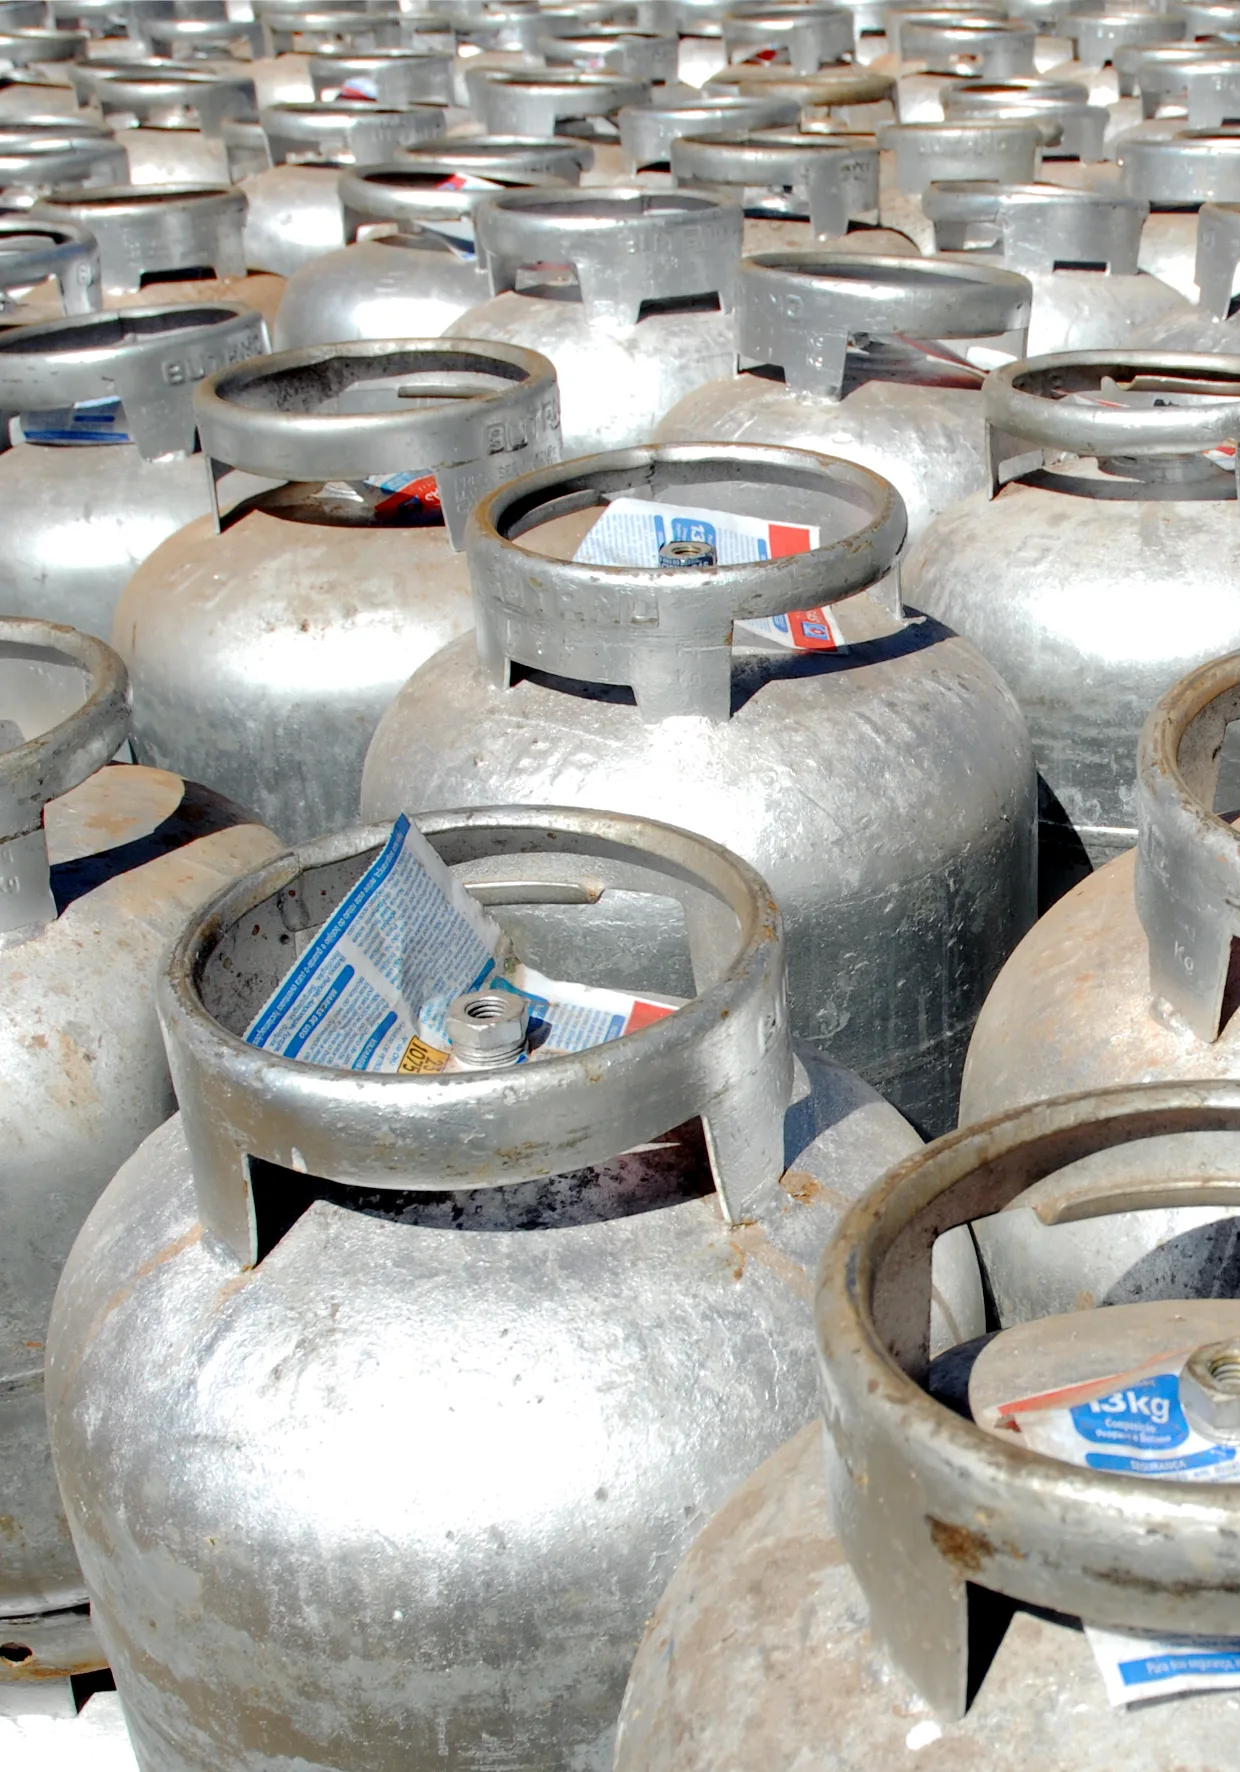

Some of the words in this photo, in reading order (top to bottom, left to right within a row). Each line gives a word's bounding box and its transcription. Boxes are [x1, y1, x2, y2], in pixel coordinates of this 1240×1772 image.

[300, 946, 324, 973] guarde-o
[275, 983, 299, 1011] eventuais
[314, 988, 337, 1016] MARCAS
[297, 1023, 311, 1039] USO
[308, 1014, 318, 1025] DE
[402, 1041, 430, 1072] 1075
[422, 1055, 441, 1073] 23
